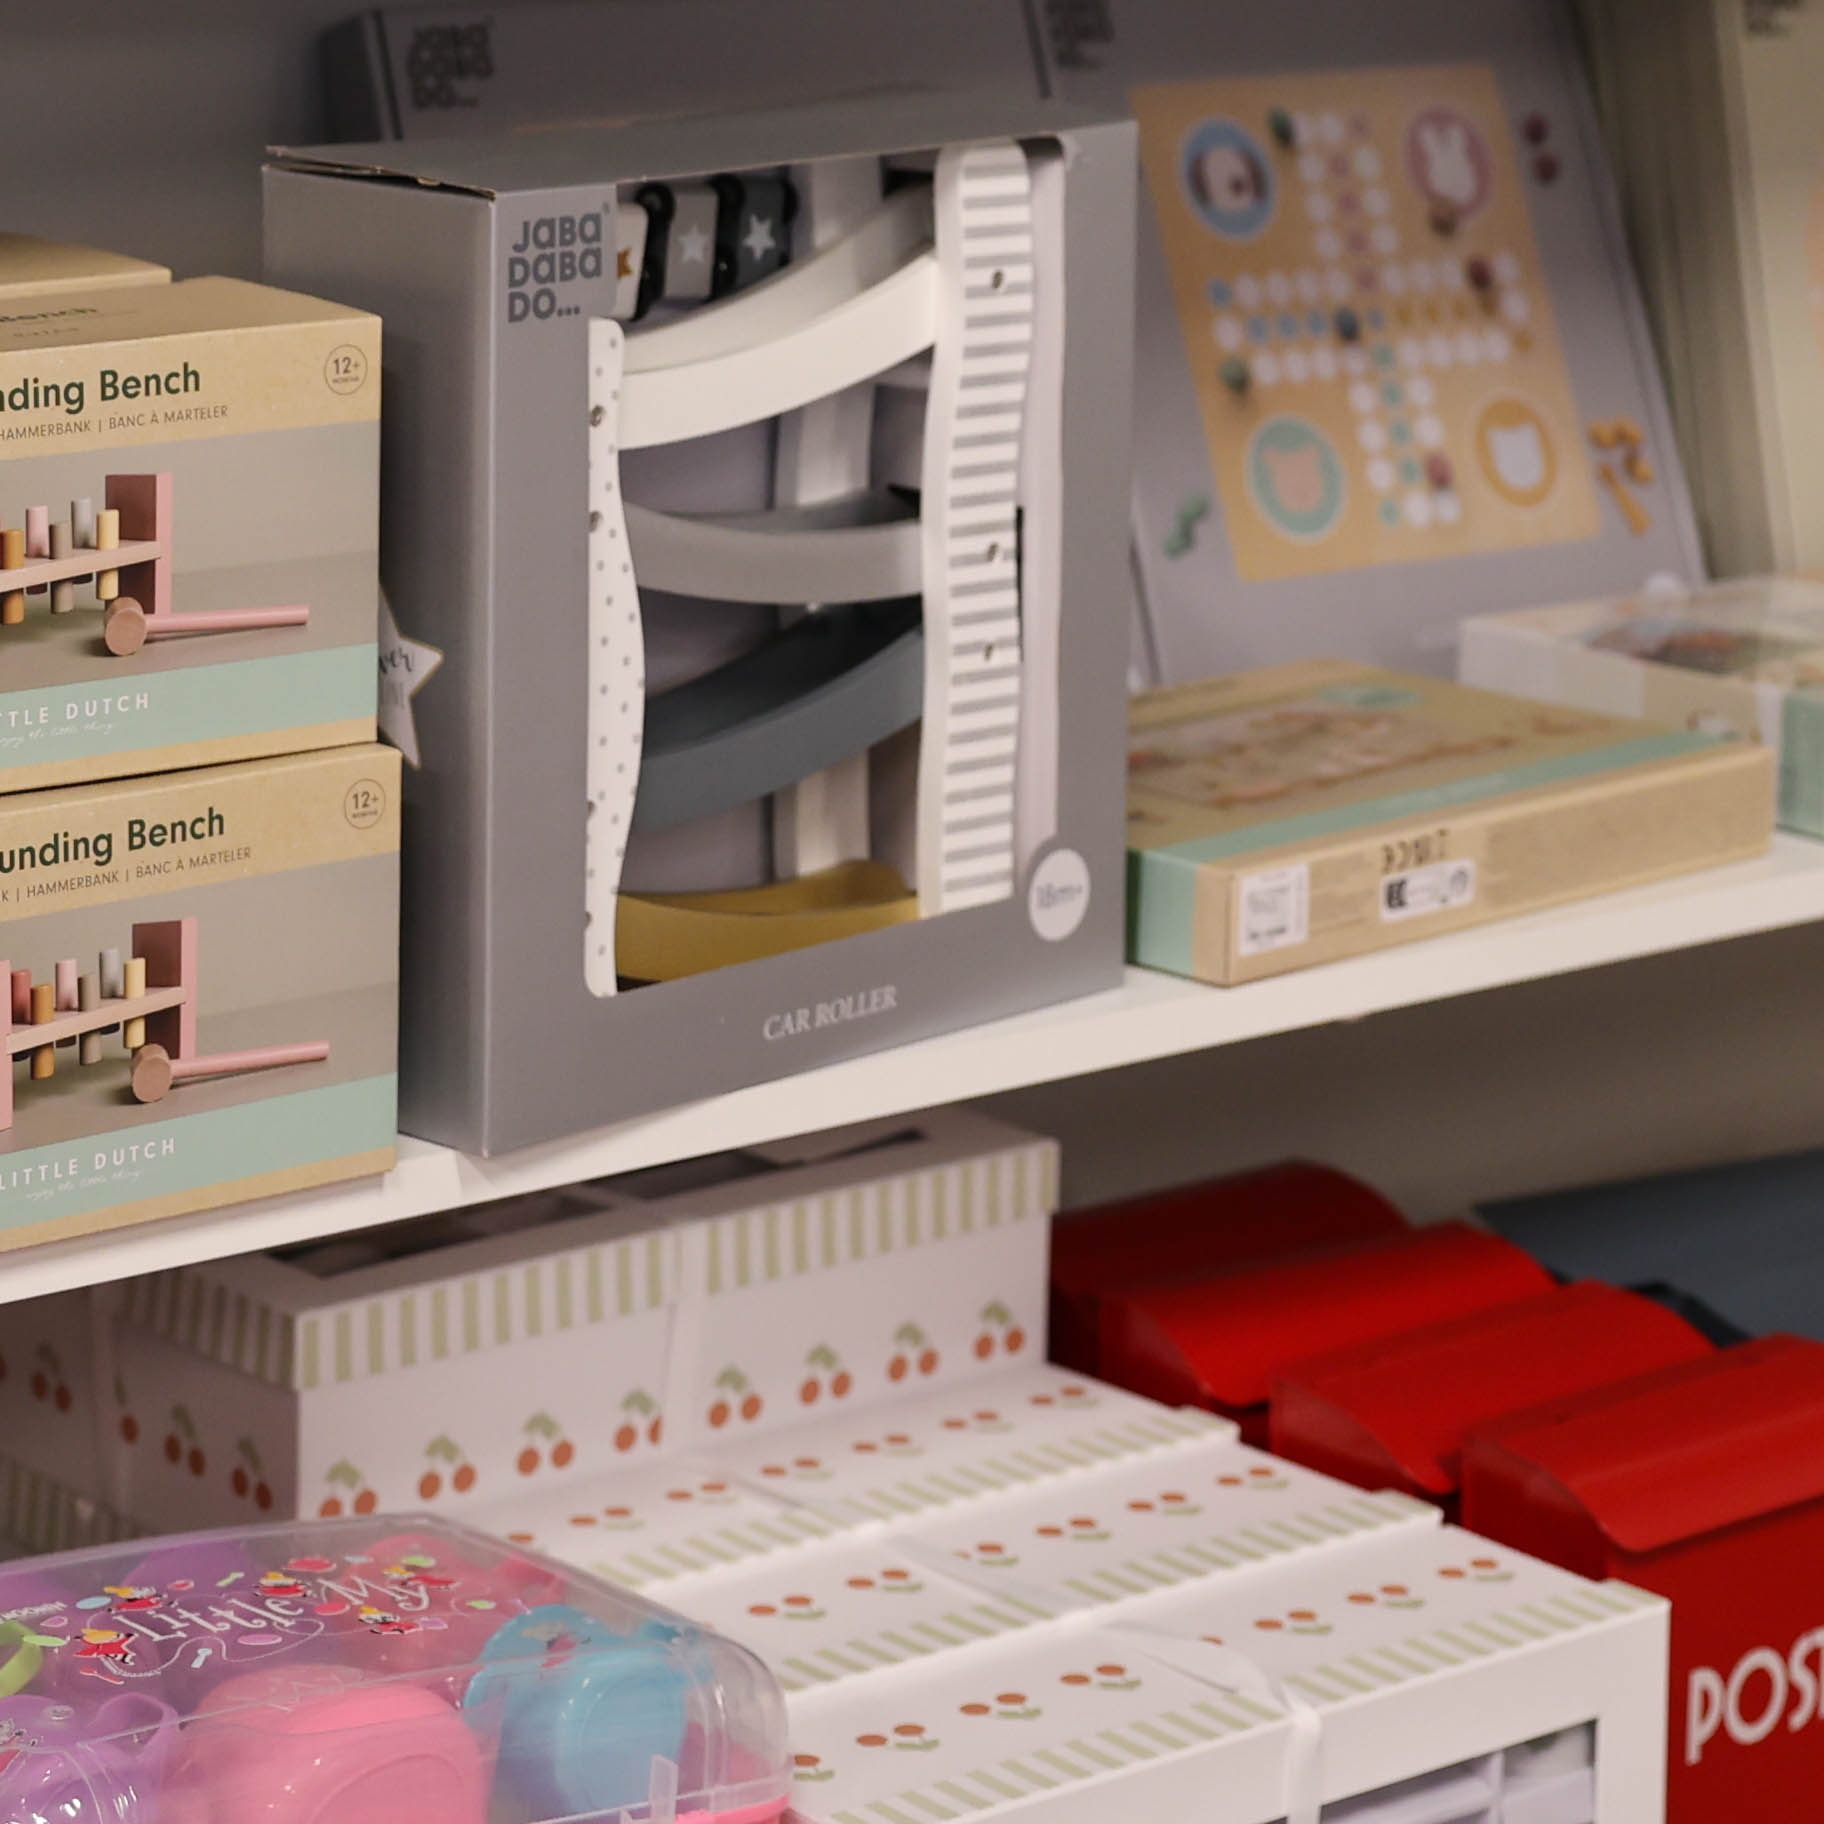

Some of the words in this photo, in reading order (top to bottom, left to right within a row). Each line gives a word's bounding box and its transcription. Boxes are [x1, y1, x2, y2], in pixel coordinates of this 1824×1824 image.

[99, 361, 201, 402] Bench
[109, 414, 146, 431] BANC
[164, 404, 229, 424] MARTELER
[66, 692, 149, 721] DUTCH
[127, 806, 225, 852] Bench
[26, 872, 120, 899] HAMMERBANK
[136, 863, 172, 880] BANC
[189, 846, 252, 869] MARTELER
[763, 1006, 812, 1041] CAR
[815, 984, 897, 1029] ROLLER
[94, 1136, 176, 1171] DUTCH
[112, 1594, 305, 1642] Little
[319, 1573, 431, 1612] My
